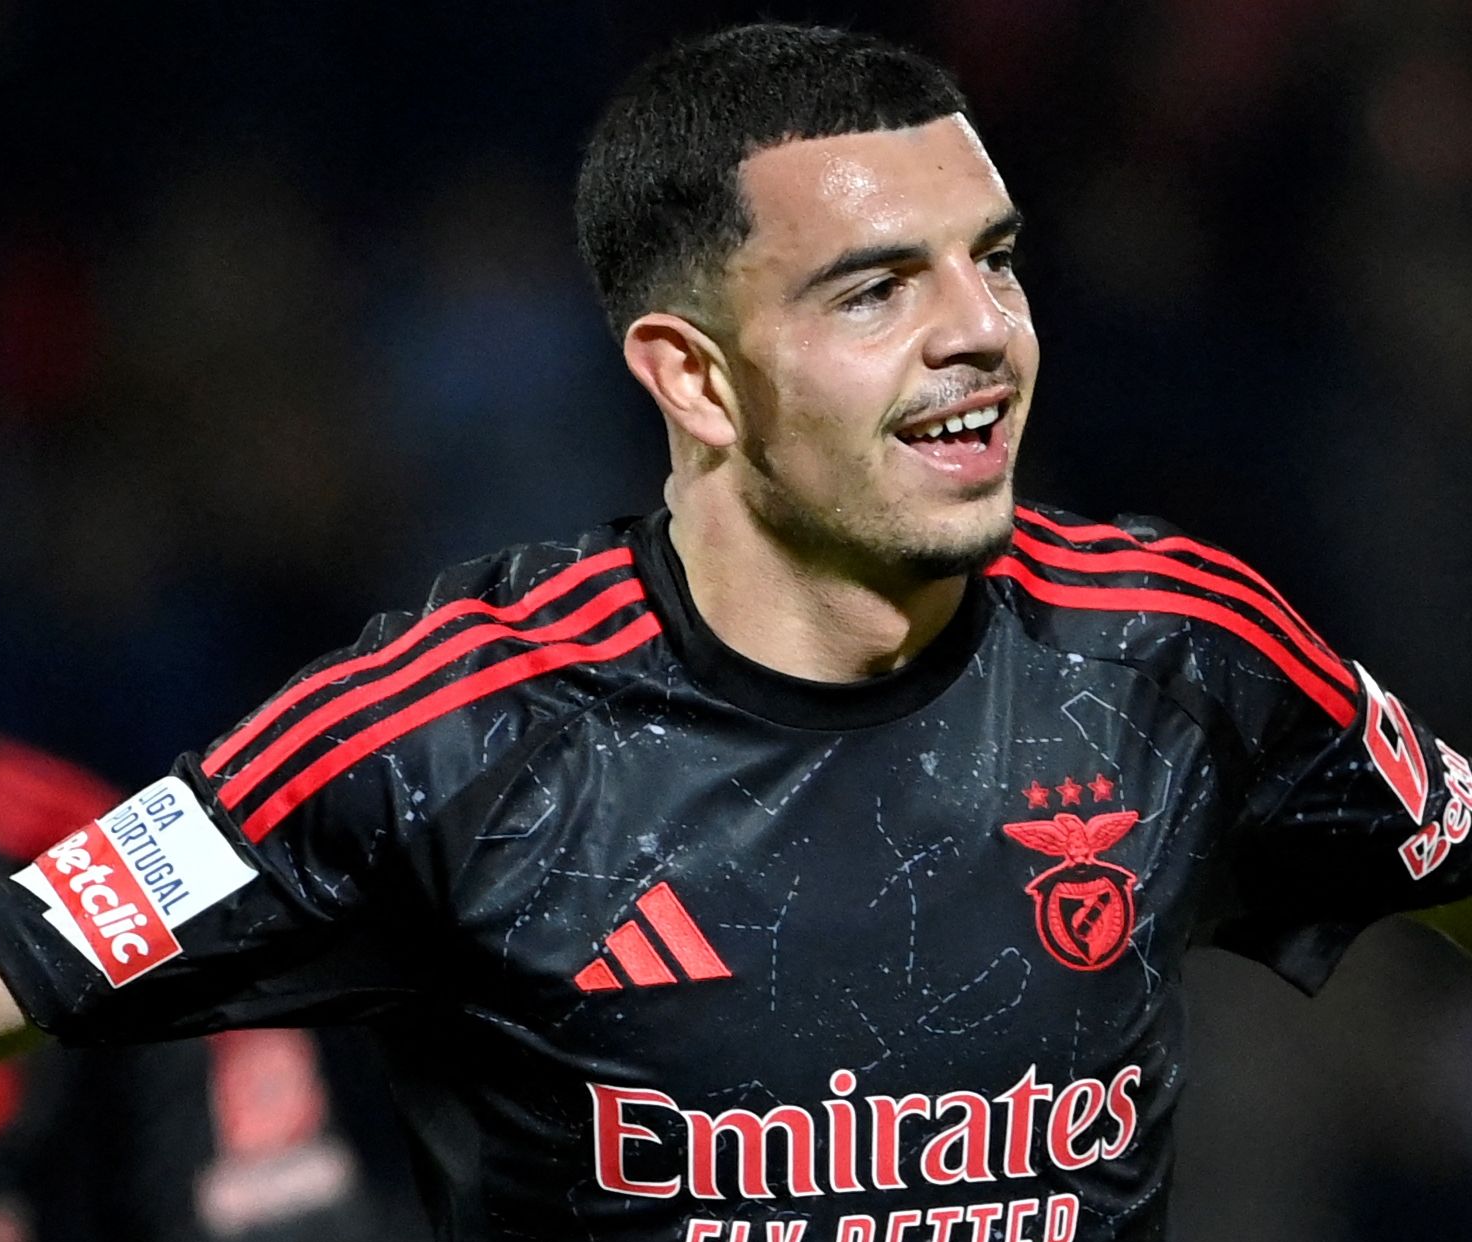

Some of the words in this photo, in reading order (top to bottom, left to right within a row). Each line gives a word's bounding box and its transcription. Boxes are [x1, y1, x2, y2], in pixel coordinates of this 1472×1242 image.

[47, 830, 149, 965] Betclic
[105, 805, 190, 916] PORTUGAL
[586, 1063, 1142, 1199] Emirates
